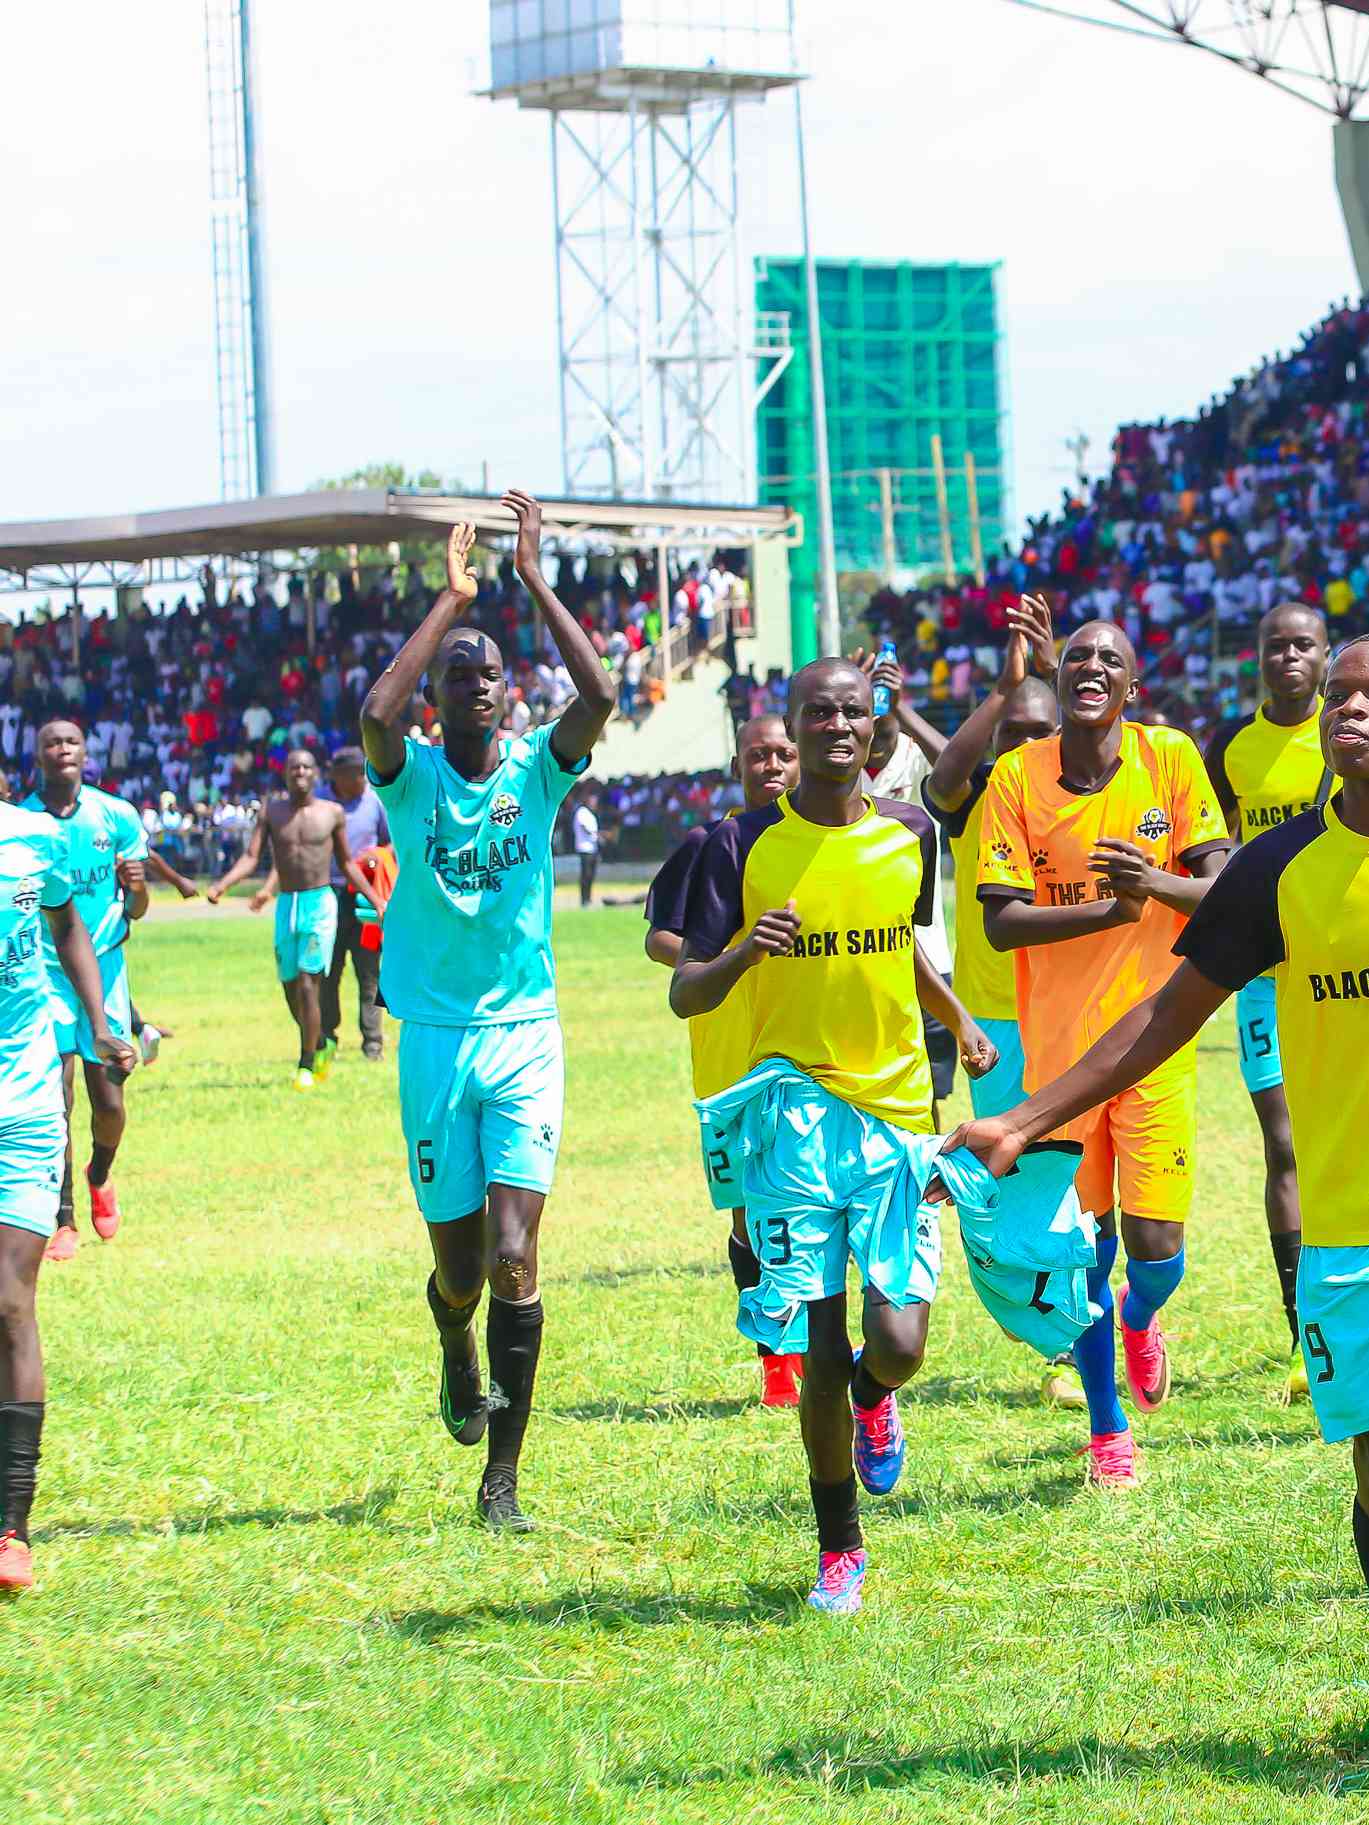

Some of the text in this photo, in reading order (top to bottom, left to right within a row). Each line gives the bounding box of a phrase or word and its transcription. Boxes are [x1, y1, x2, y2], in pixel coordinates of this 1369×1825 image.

[458, 834, 531, 875] BLACK
[769, 931, 839, 958] ACK
[1239, 1017, 1271, 1062] 15
[417, 1140, 435, 1183] 6
[1305, 1322, 1335, 1383] 9
